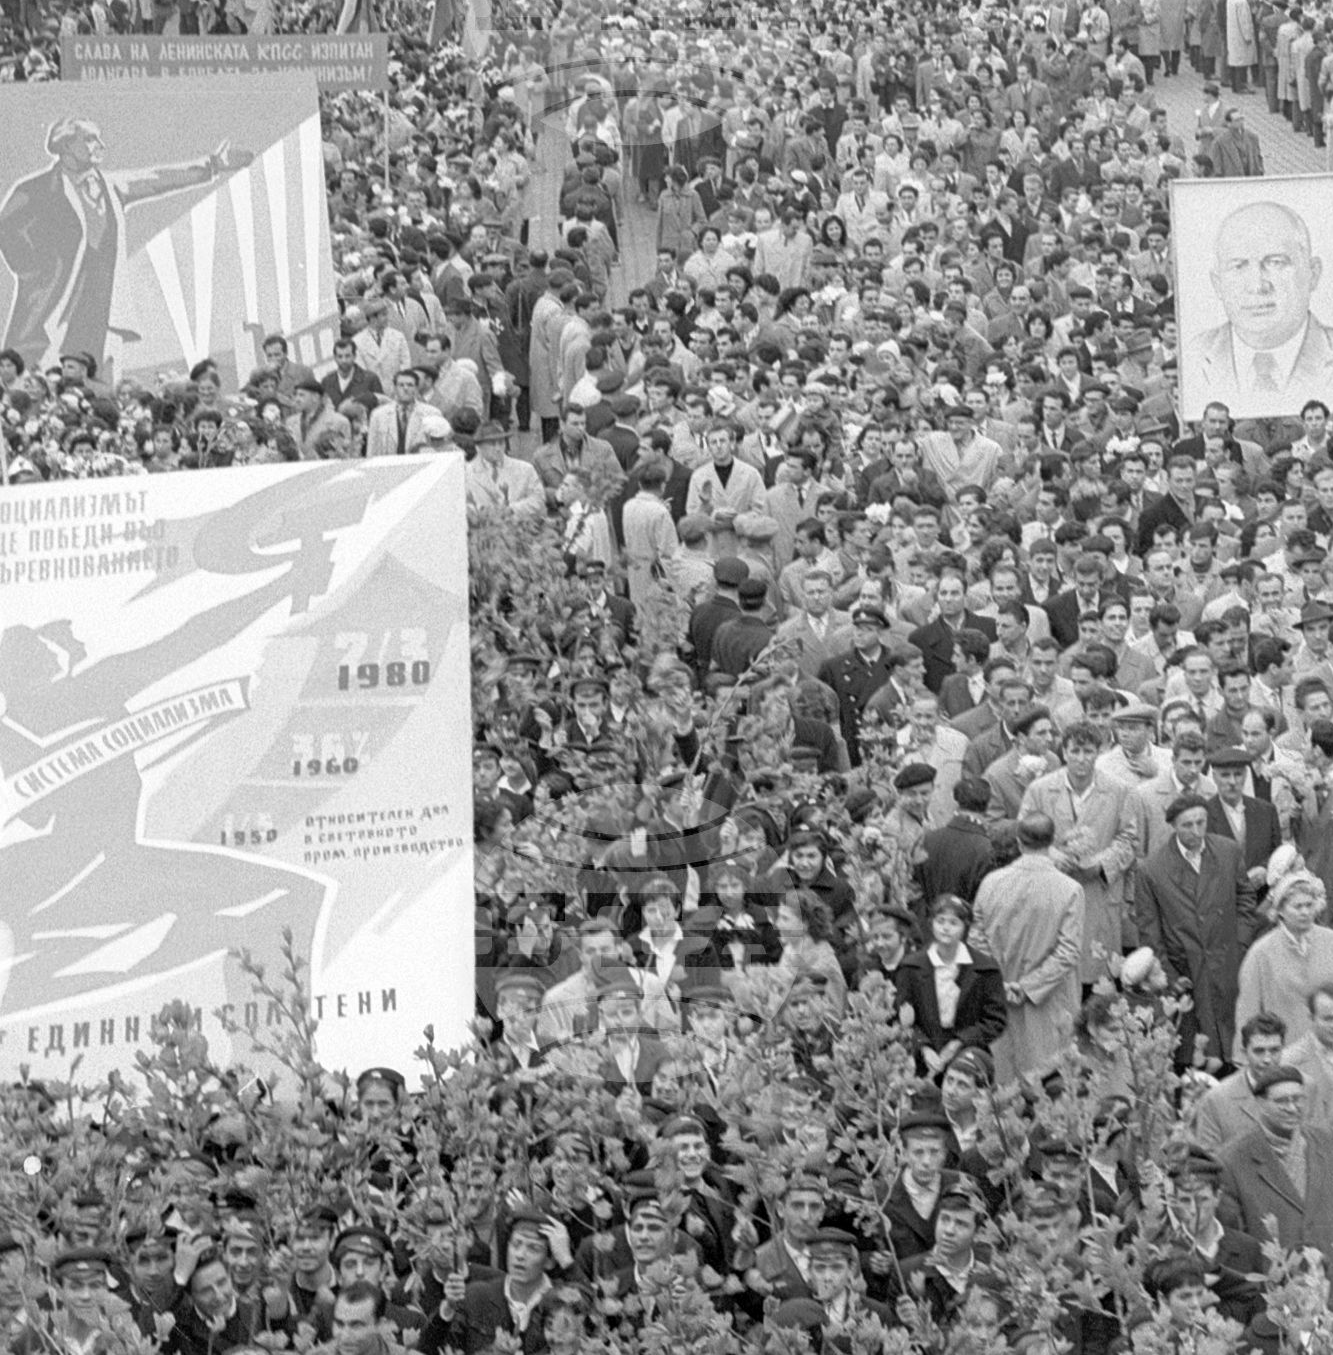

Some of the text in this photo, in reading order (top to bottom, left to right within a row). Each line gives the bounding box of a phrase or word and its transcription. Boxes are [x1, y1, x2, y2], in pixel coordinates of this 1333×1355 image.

[74, 42, 122, 61] СЛАВА
[130, 42, 150, 61] НА
[158, 42, 250, 61] ЛЕНИНСКАТА
[310, 41, 374, 60] ИЗПИТАН
[0, 490, 148, 526] ОЦИАЛИЗМЪТ
[29, 523, 113, 553] ПОБЕДИ
[0, 545, 180, 585] ЪРЕВНОВАНИЕТО
[337, 659, 431, 691] 1980
[13, 687, 234, 799] СИСТЕМА СОЦИАЛИЗМА
[292, 756, 359, 777] 1960
